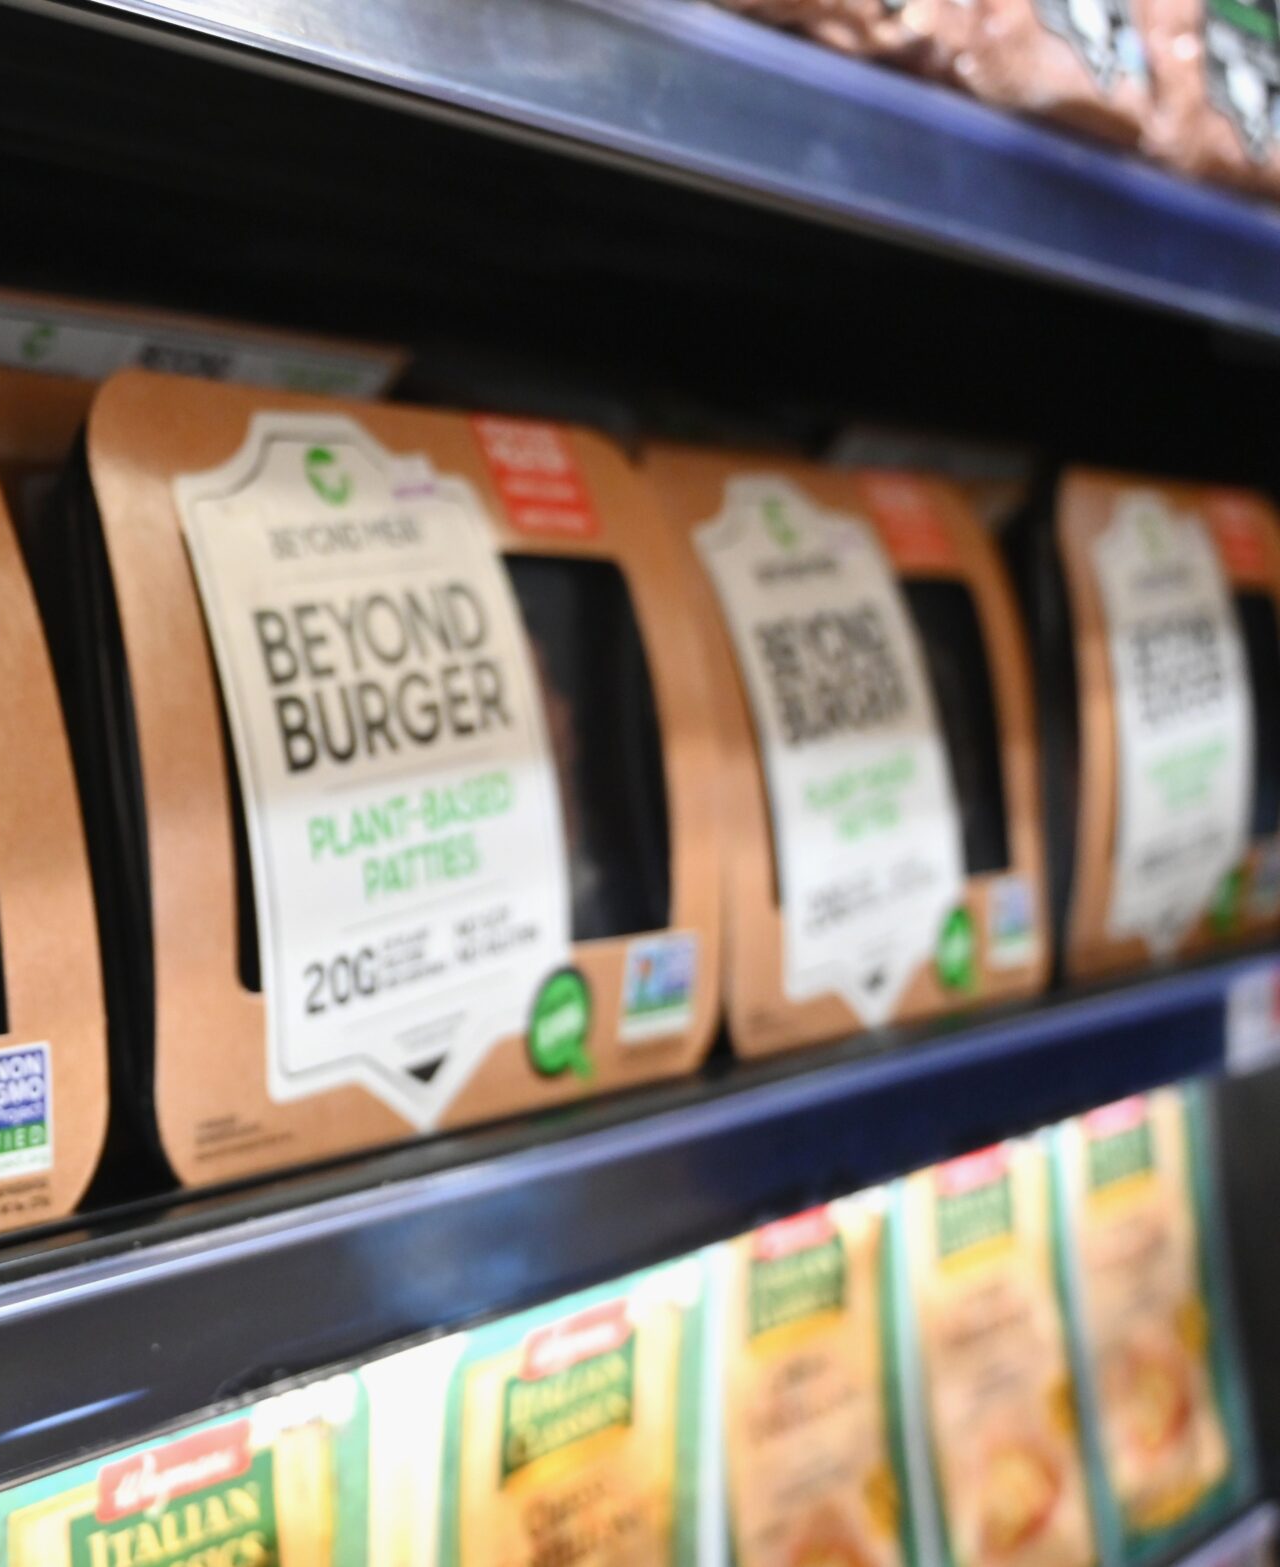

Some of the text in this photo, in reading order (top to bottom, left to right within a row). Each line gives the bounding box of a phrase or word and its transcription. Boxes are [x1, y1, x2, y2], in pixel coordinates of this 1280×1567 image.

[254, 582, 488, 687] BEYOND
[276, 659, 512, 775] BURGER
[309, 772, 514, 860] PLANT-BASED
[363, 835, 481, 900] PATTIES
